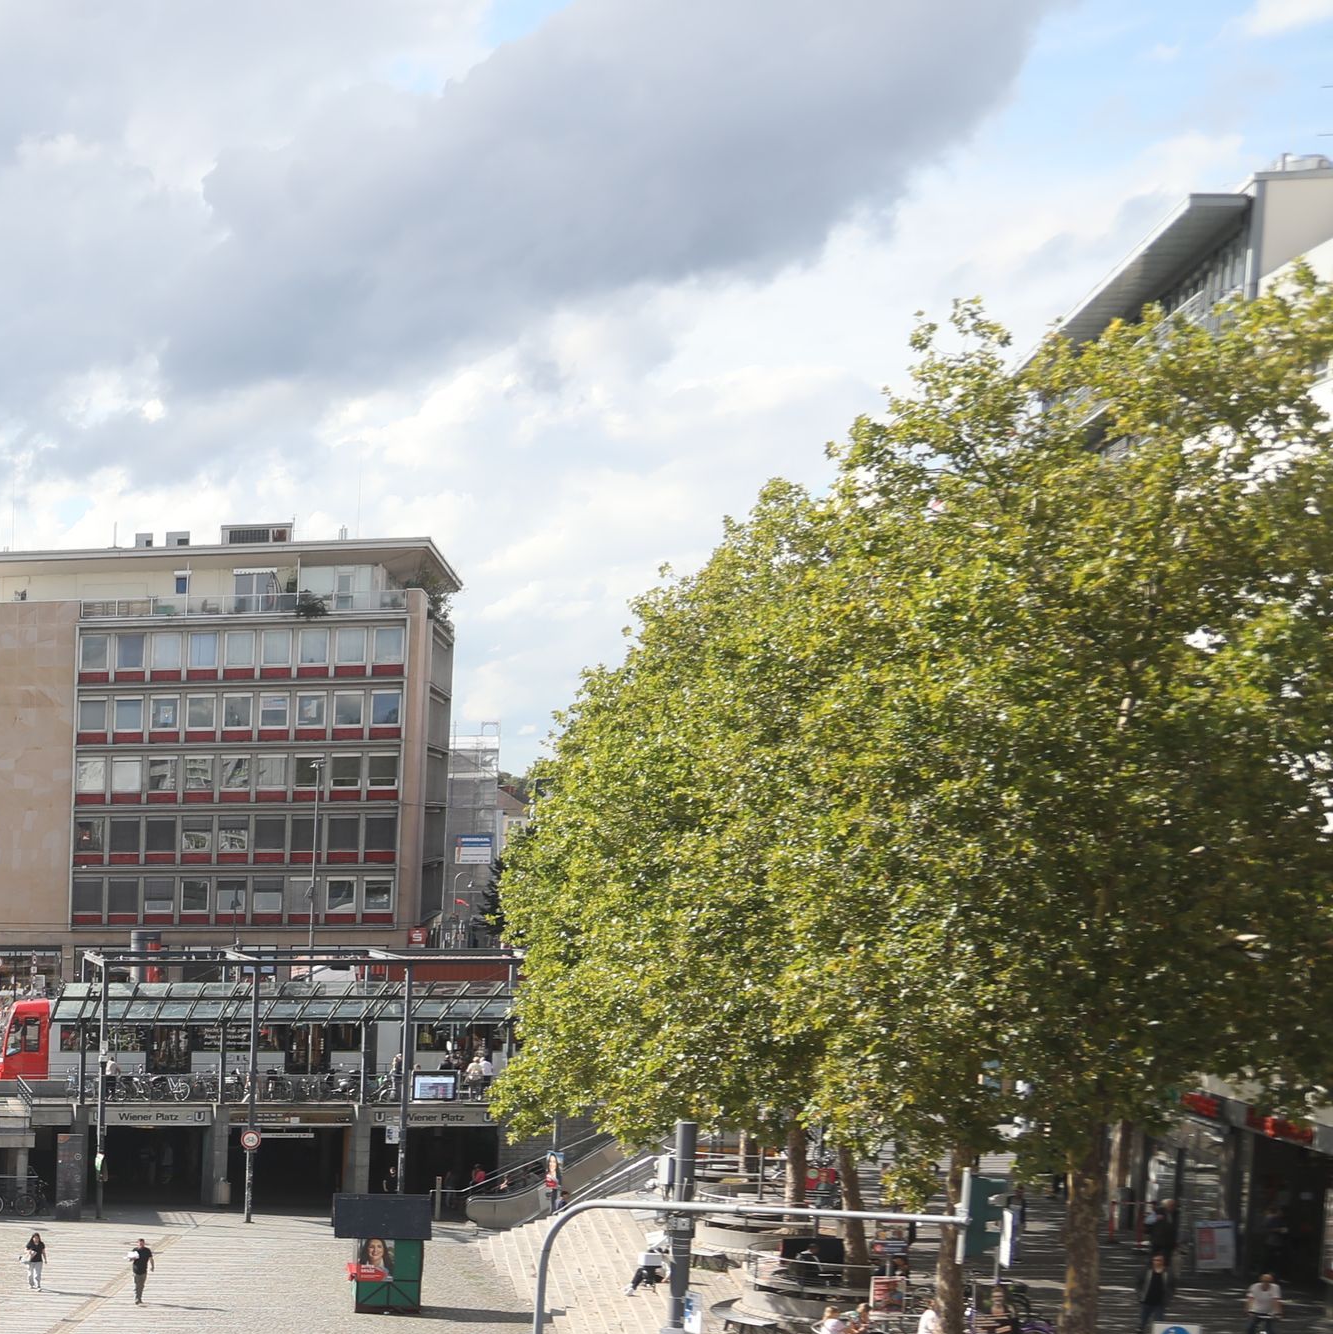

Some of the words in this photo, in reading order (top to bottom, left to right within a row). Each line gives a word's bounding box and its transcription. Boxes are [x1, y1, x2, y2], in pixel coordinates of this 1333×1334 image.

[118, 1112, 153, 1122] Wiener
[156, 1112, 179, 1122] Platz
[194, 1112, 205, 1122] U
[375, 1112, 385, 1122] U
[441, 1112, 465, 1122] Platz
